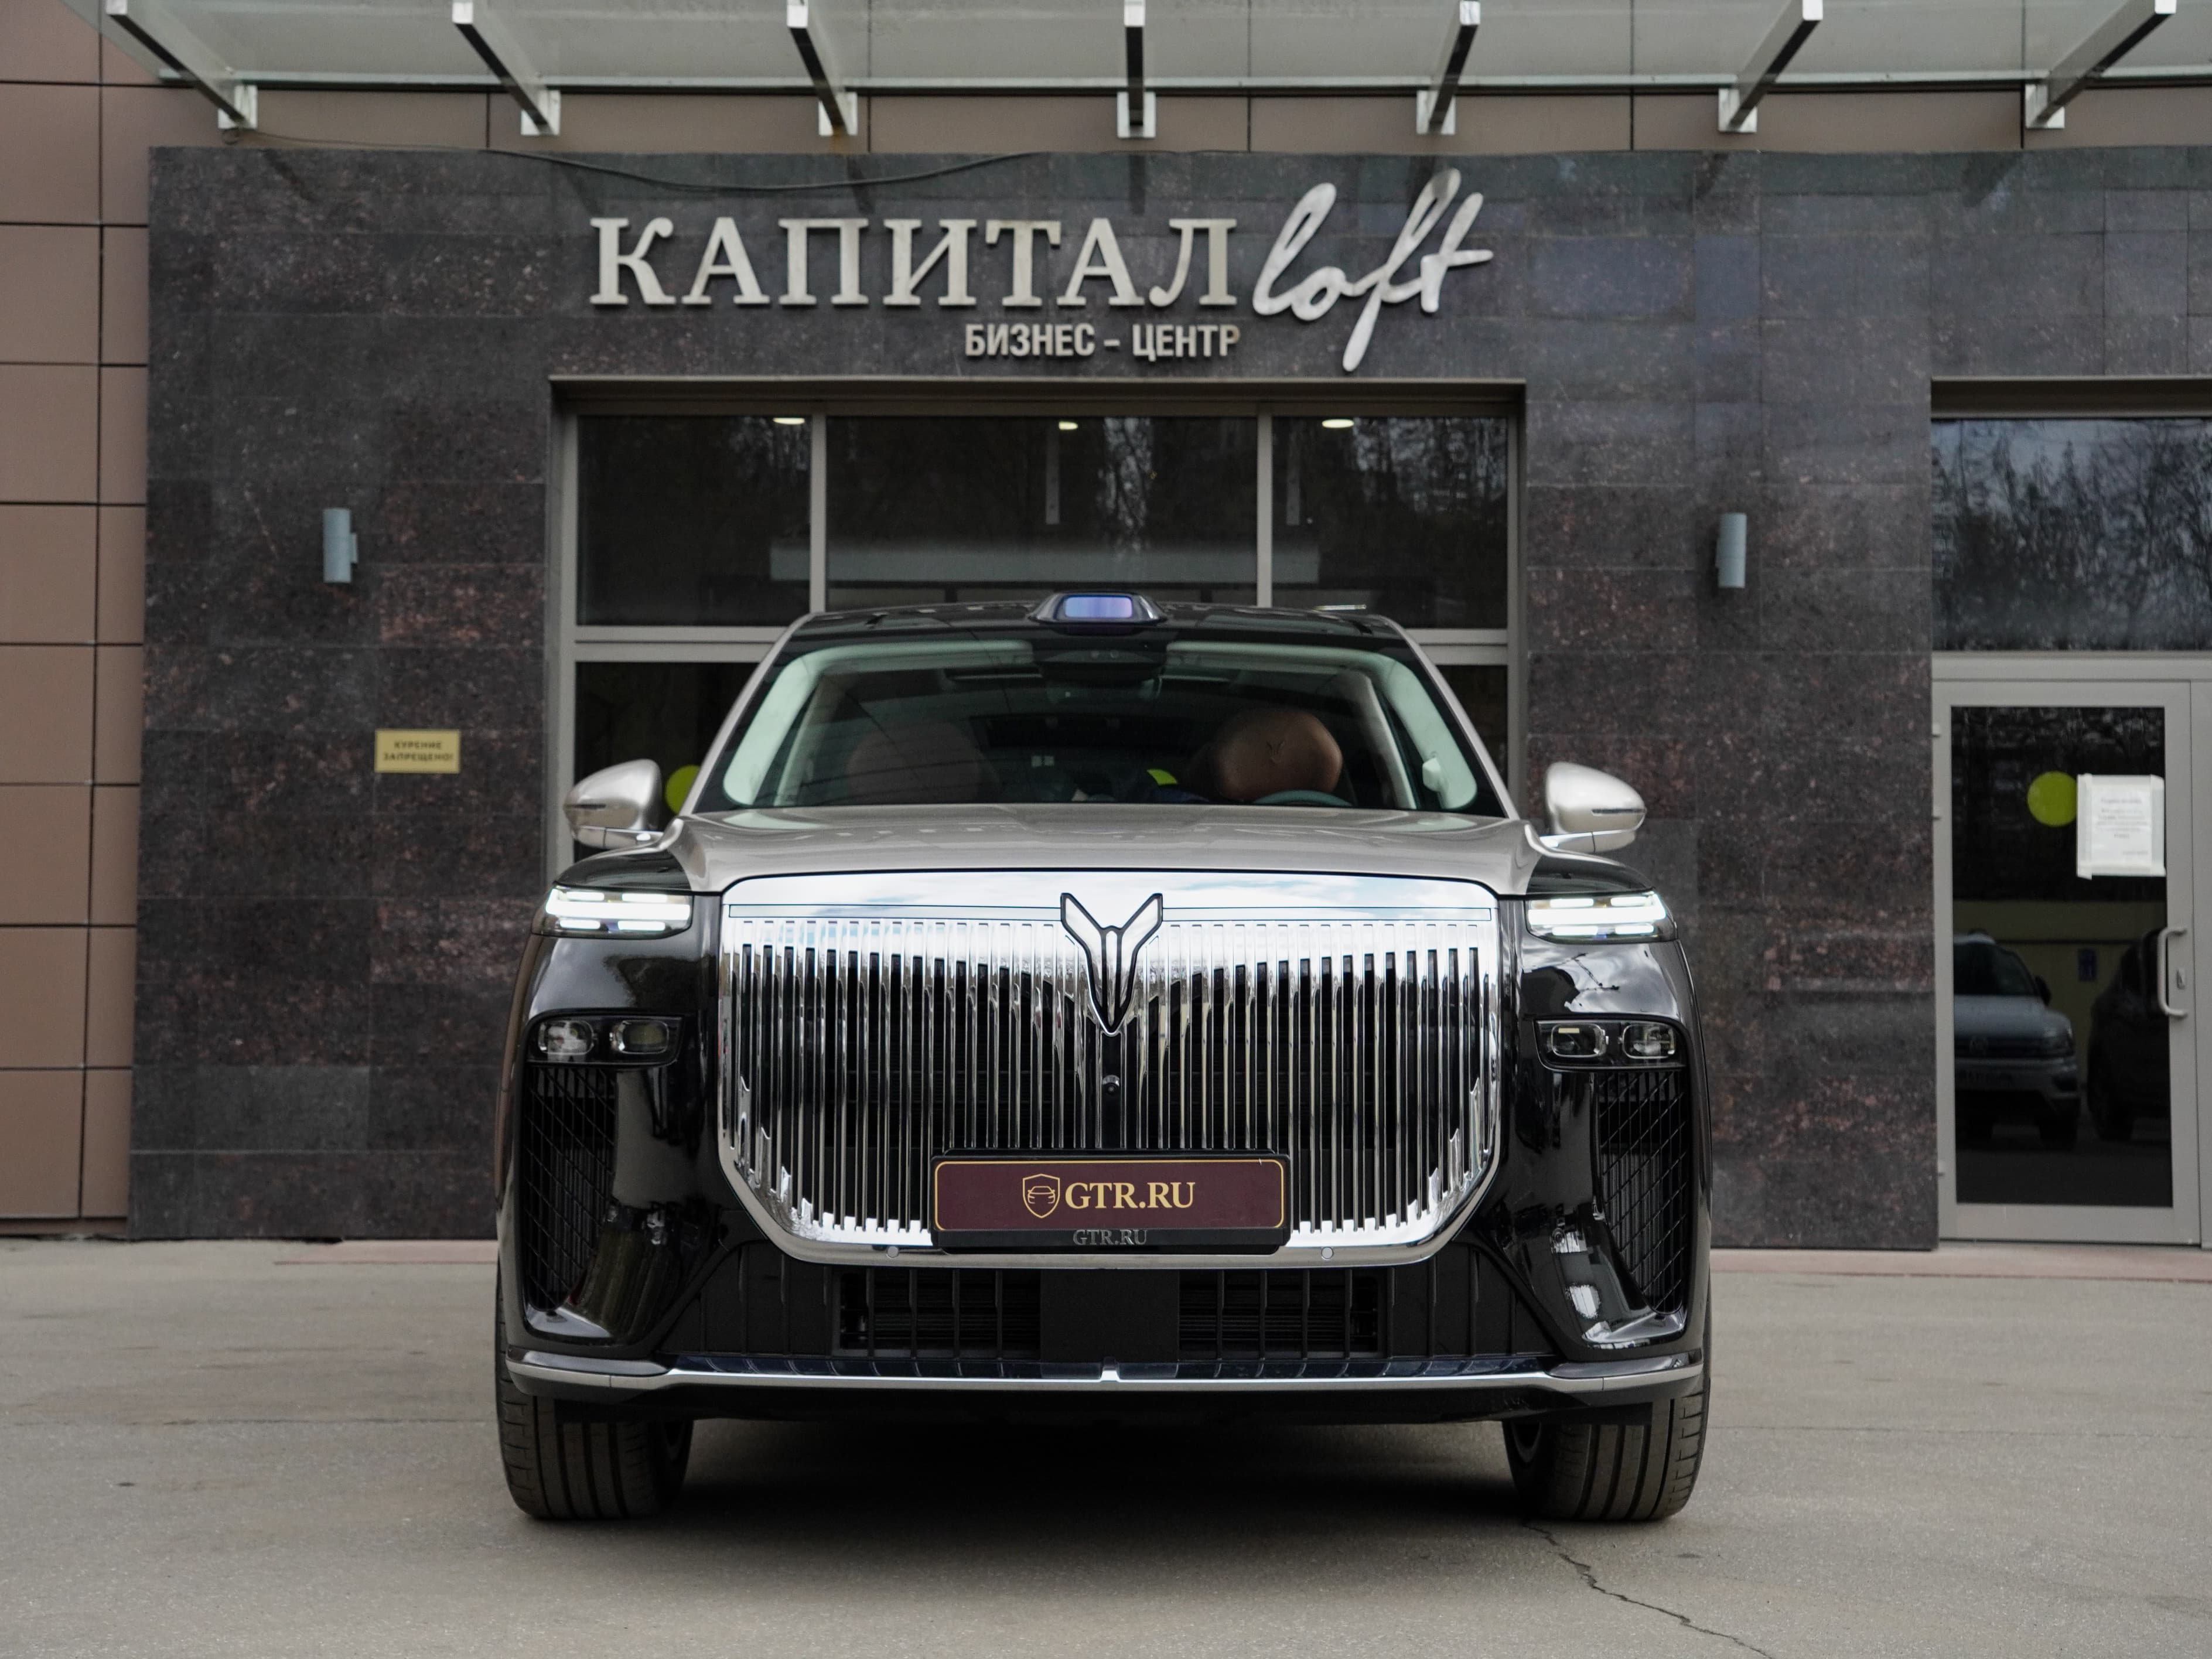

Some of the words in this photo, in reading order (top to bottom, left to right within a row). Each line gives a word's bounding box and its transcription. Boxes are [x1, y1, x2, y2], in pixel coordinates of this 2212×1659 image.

[590, 217, 1237, 306] КАПИТАЛ
[1253, 169, 1494, 372] loft
[965, 323, 1095, 356] БИЗНЕС
[1132, 324, 1240, 361] ЦЕНТР
[394, 741, 441, 749] КУРЕНИЕ
[1065, 1182, 1196, 1209] GTR.RU
[1073, 1230, 1148, 1245] GTR.RU
